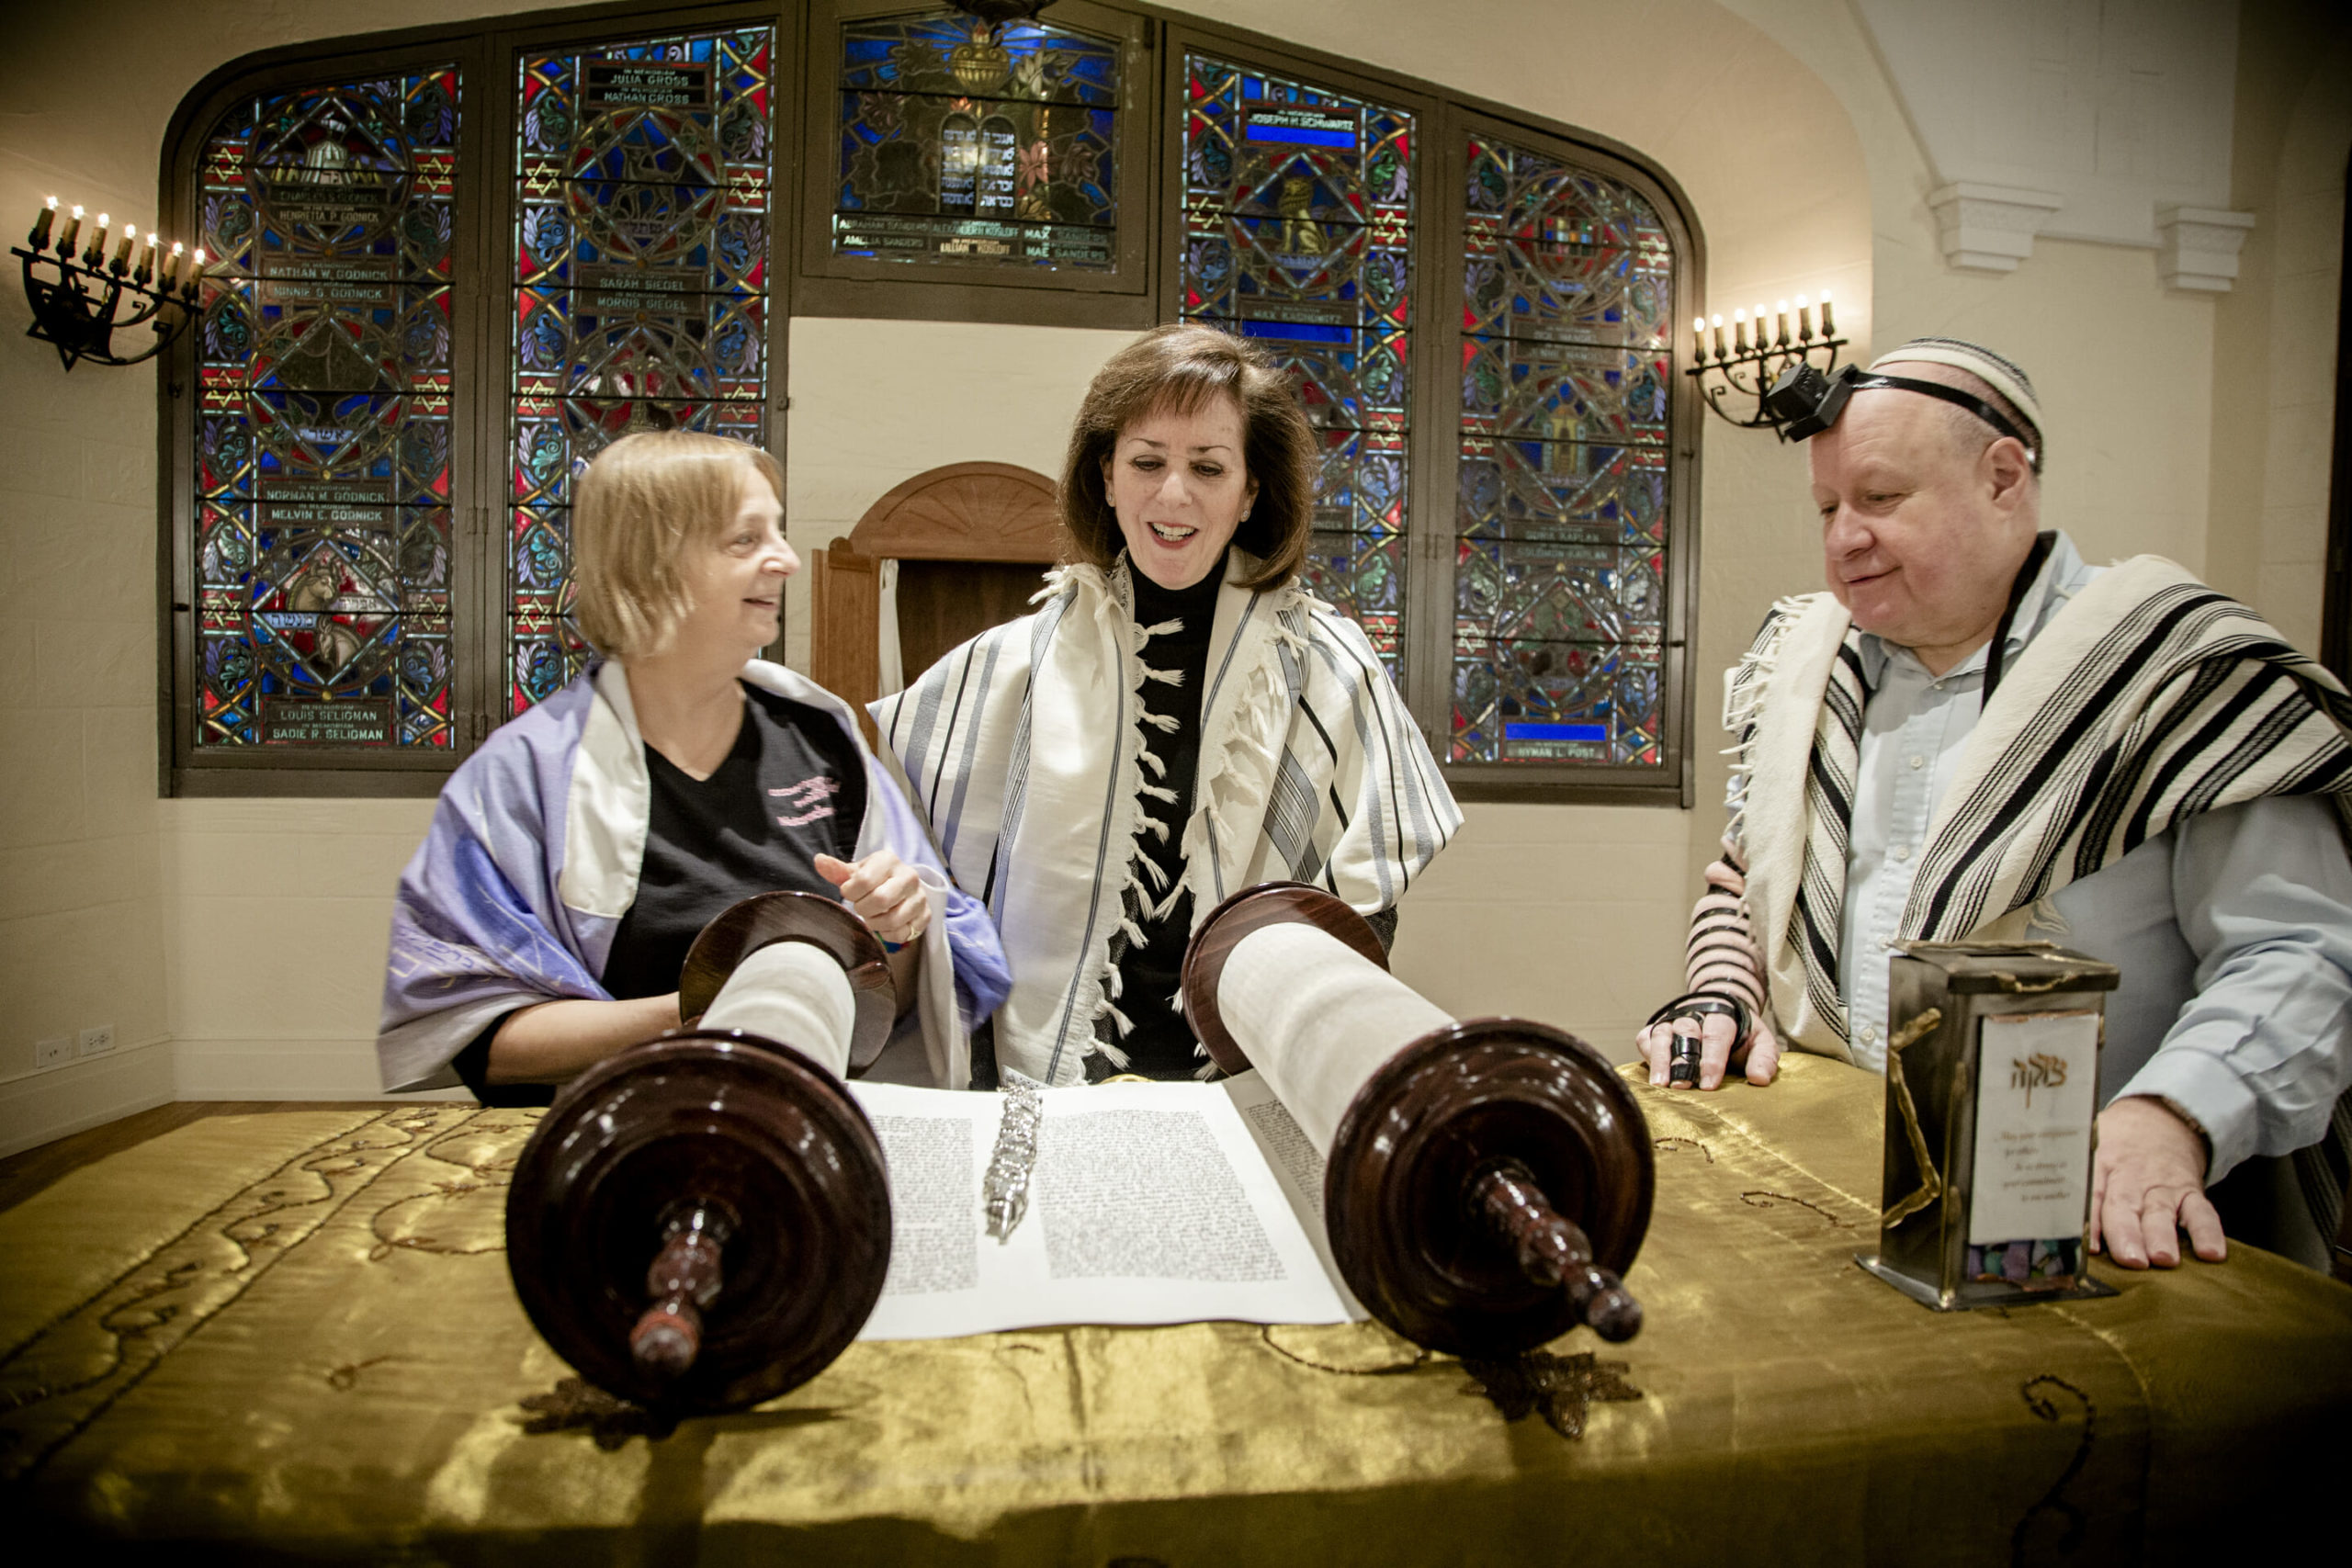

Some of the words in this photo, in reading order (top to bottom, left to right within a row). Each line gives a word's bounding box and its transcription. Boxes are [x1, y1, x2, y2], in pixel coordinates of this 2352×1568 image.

[610, 74, 642, 85] JULIA
[647, 75, 689, 87] GROSS
[604, 92, 647, 103] NATHAN
[648, 94, 690, 105] GROSS
[1248, 113, 1289, 125] JOSEPH
[1300, 117, 1355, 131] SCHWARTZ
[279, 210, 325, 221] HENRIETTA
[341, 211, 379, 223] GODNICK
[1024, 229, 1050, 241] MAX
[1054, 248, 1106, 260] SANDERS
[269, 266, 317, 278] NATHAN
[336, 269, 389, 281] GODNICK
[599, 278, 639, 288] SARAH
[645, 279, 684, 291] SIEGEL
[274, 287, 311, 297] MINNIE
[331, 288, 383, 299] GODNICK
[597, 297, 640, 309] MORRIS
[646, 299, 687, 310] SIEGEL
[266, 490, 315, 501] NORMAN
[271, 509, 313, 520] MELVIN
[331, 510, 383, 521] GODNICK
[280, 710, 315, 720] LOUIS
[319, 710, 378, 721] SELIGMAN
[273, 728, 307, 739] SADIE
[325, 729, 384, 740] SELIGMAN
[1518, 747, 1553, 757] HYMAN
[1567, 748, 1595, 758] POST
[2010, 1052, 2068, 1109] צדקה
